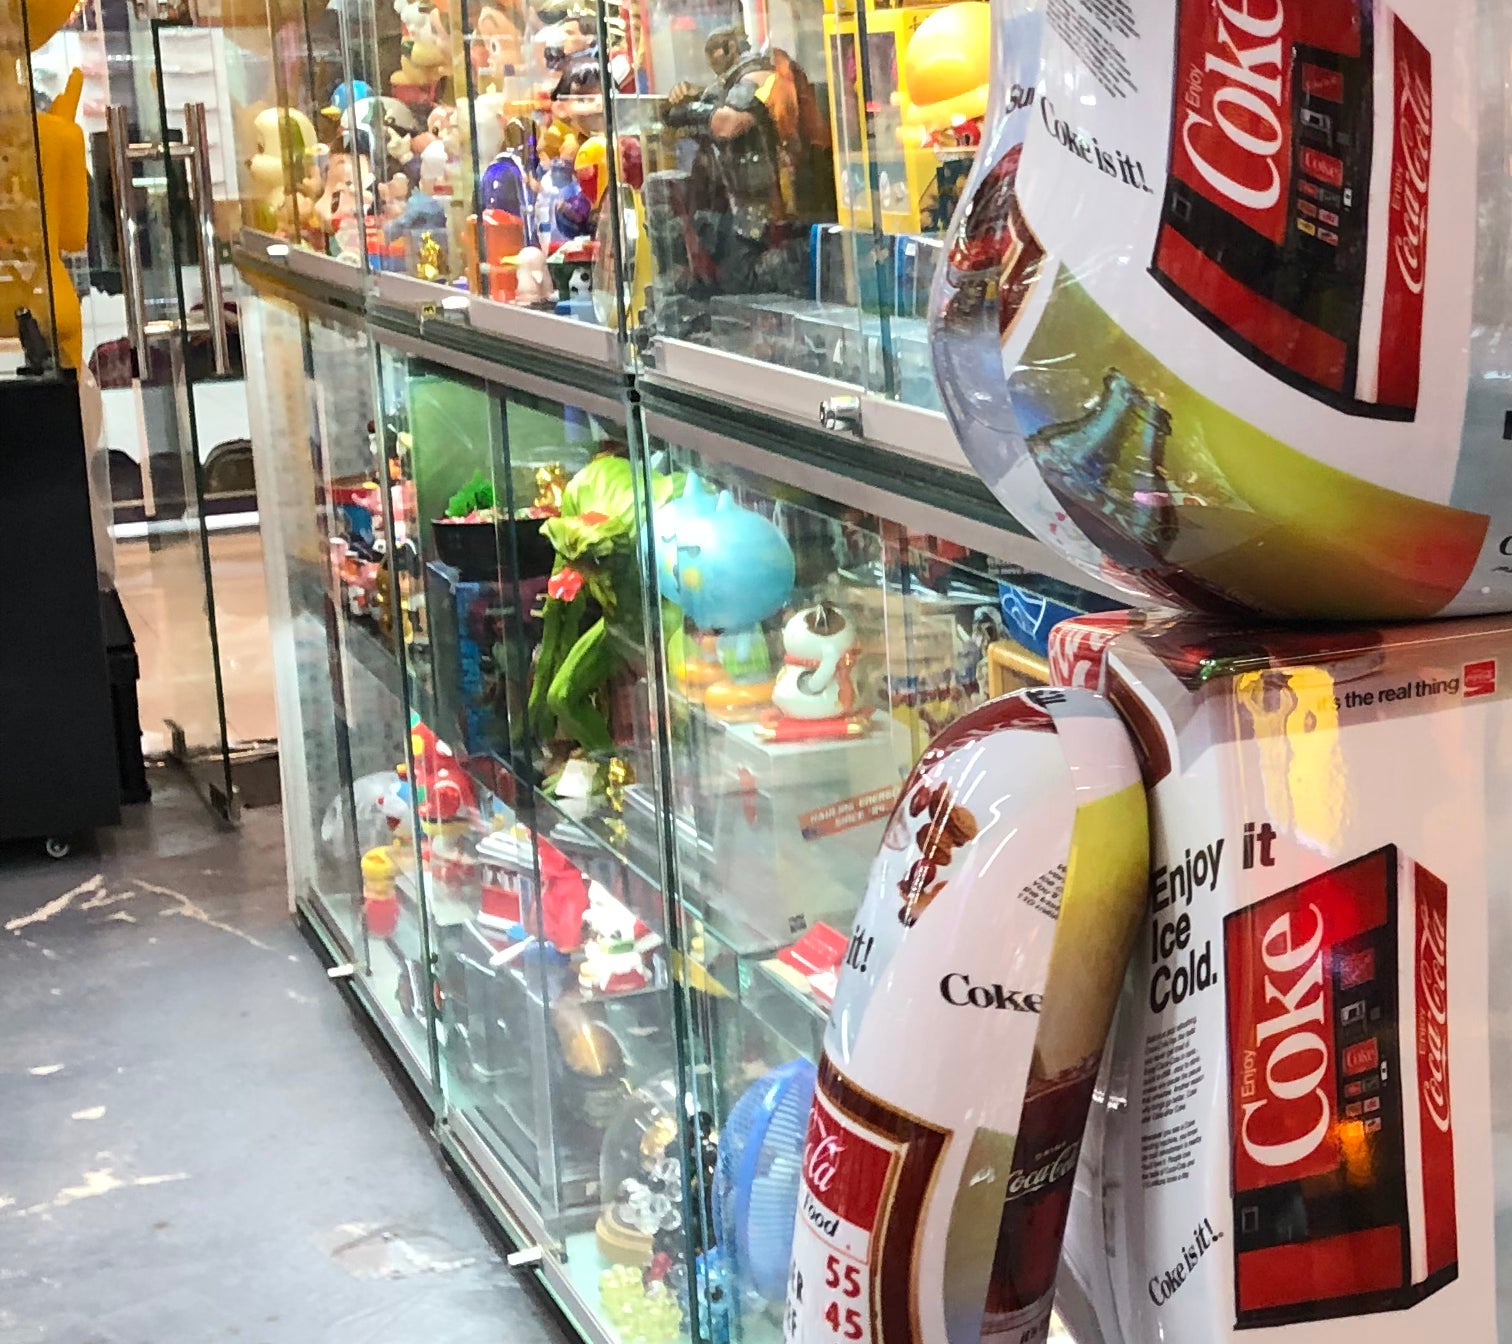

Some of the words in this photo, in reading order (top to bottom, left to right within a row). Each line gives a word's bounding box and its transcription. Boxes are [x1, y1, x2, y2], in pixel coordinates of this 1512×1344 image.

[1345, 691, 1375, 710] the
[1378, 684, 1412, 704] real
[1415, 675, 1460, 701] thing
[1152, 837, 1225, 913] Enjoy
[1242, 822, 1276, 870] it
[1152, 912, 1192, 964] Ice
[940, 972, 1045, 1013] Coke
[1150, 941, 1218, 1014] Cold.
[1241, 902, 1331, 1167] Coke
[1240, 1048, 1257, 1098] Enjoy
[824, 1255, 862, 1300] 55
[1148, 1264, 1188, 1309] Coke
[824, 1301, 864, 1342] 45
